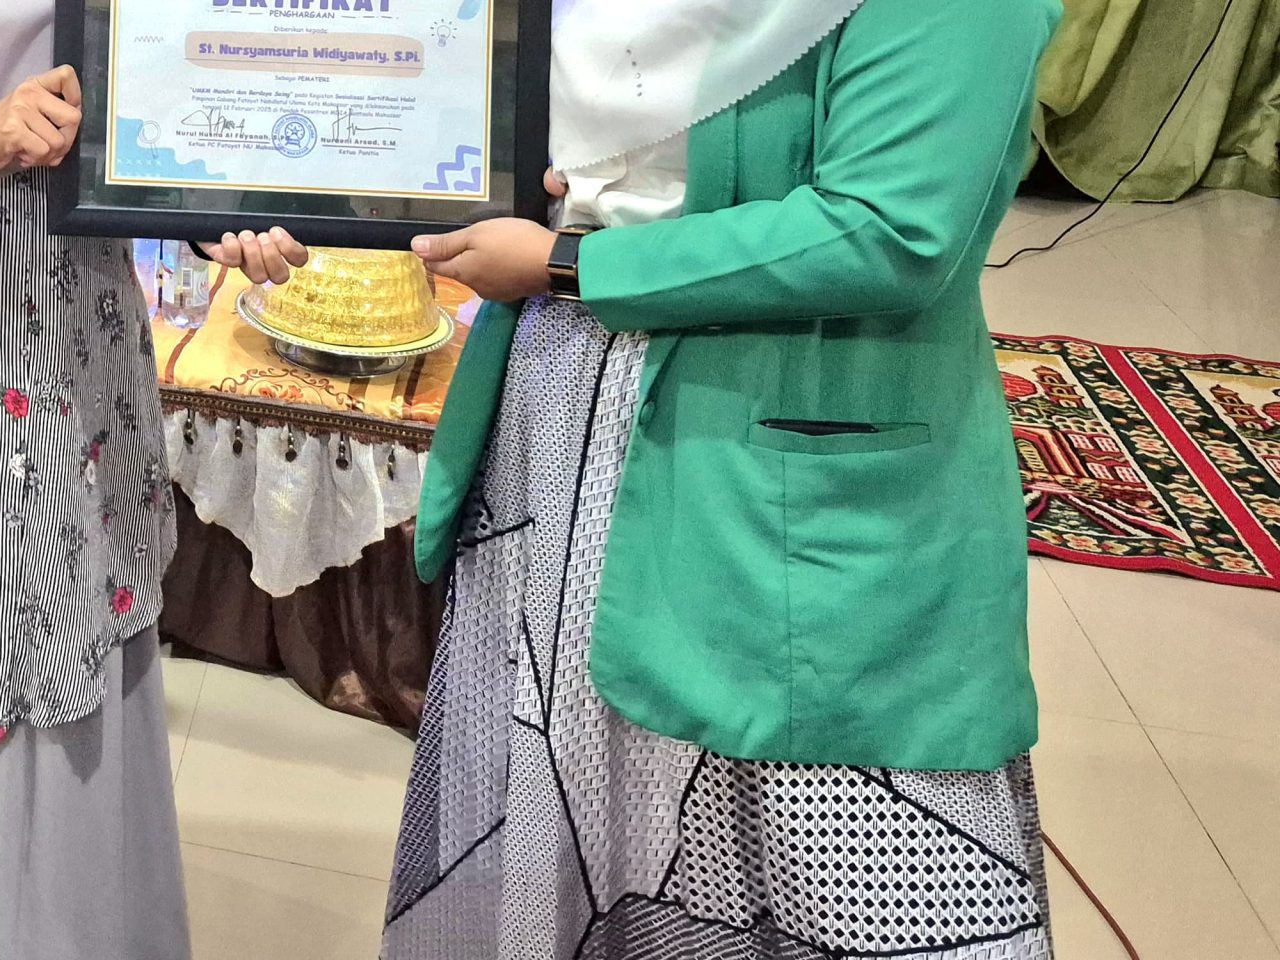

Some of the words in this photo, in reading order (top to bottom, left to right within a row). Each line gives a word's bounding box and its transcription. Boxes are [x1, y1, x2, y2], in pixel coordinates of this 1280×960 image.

[269, 9, 335, 19] PENGHARGAAN
[198, 43, 215, 54] St.
[219, 43, 309, 58] Nursyamsuria
[394, 50, 421, 62] S.Pi.
